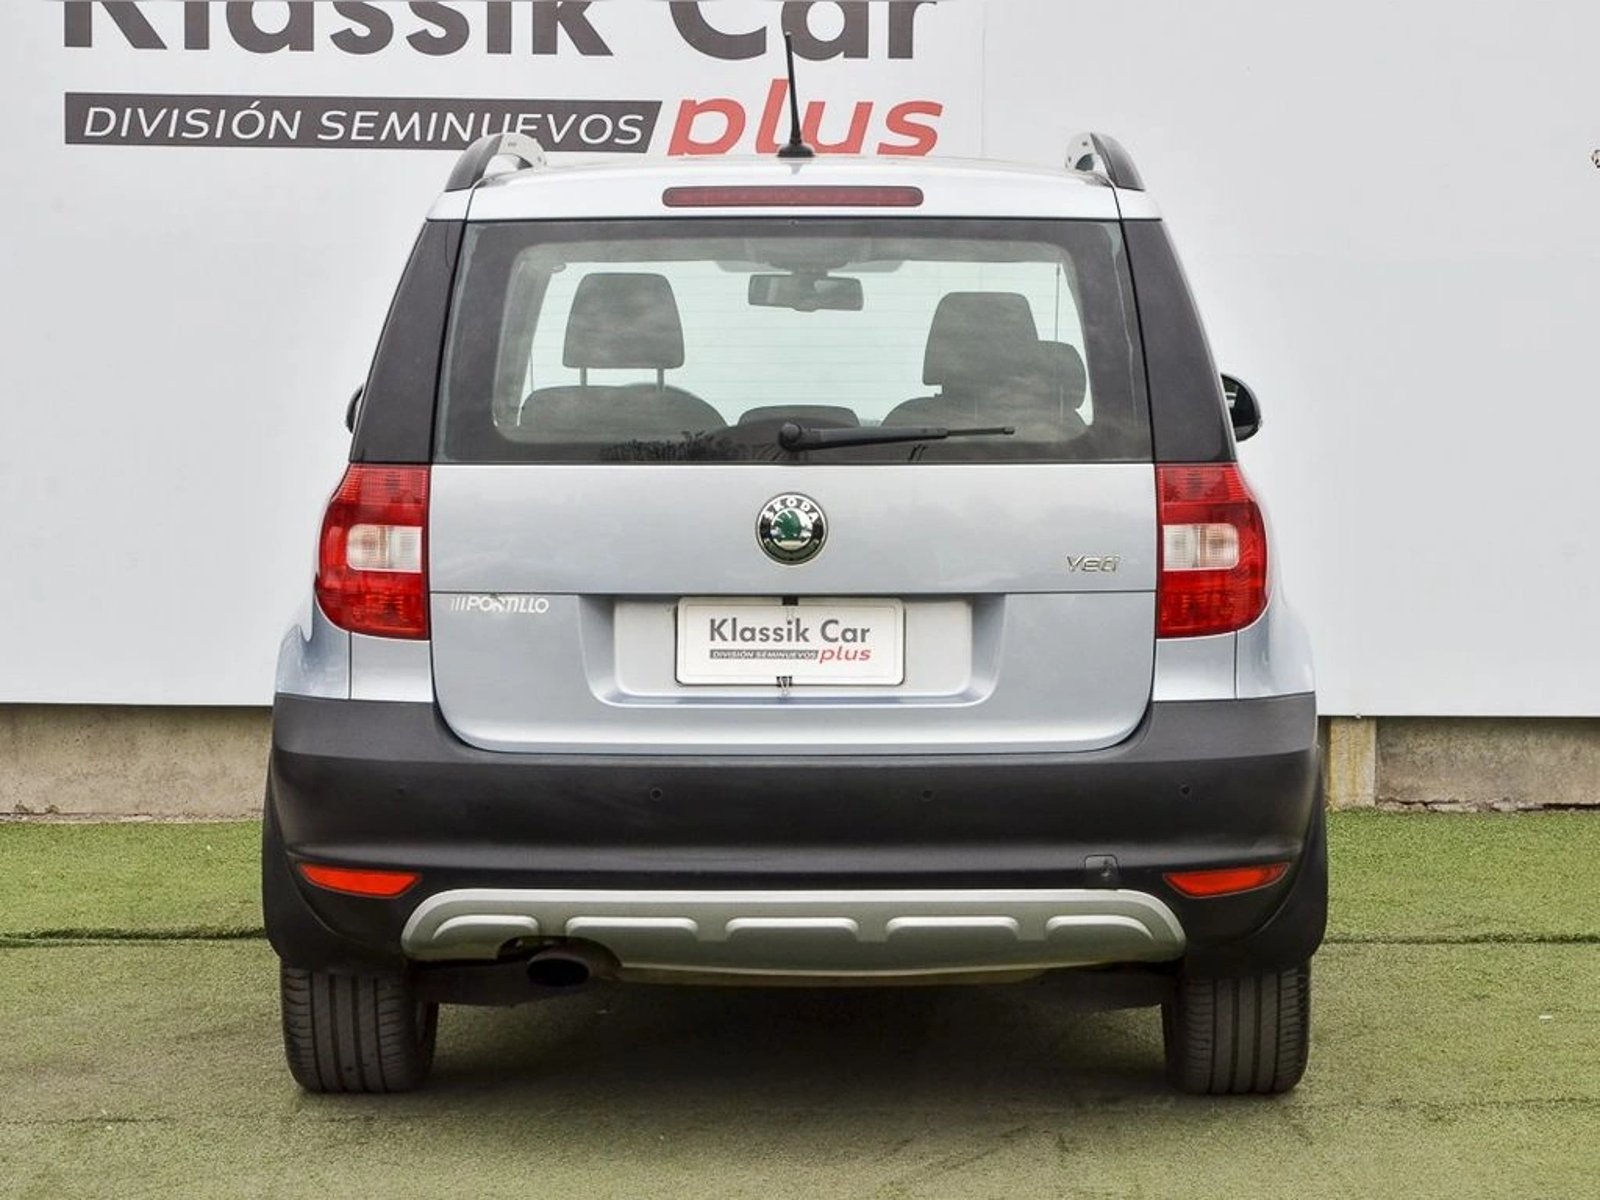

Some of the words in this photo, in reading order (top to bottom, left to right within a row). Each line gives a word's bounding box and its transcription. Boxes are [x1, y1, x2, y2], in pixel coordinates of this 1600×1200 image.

[83, 101, 302, 140] DIVISIÓN
[317, 108, 645, 146] SEMINUEVOS
[667, 79, 944, 156] plus
[709, 617, 811, 643] Klassik
[819, 618, 871, 643] Car
[819, 646, 872, 664] plus
